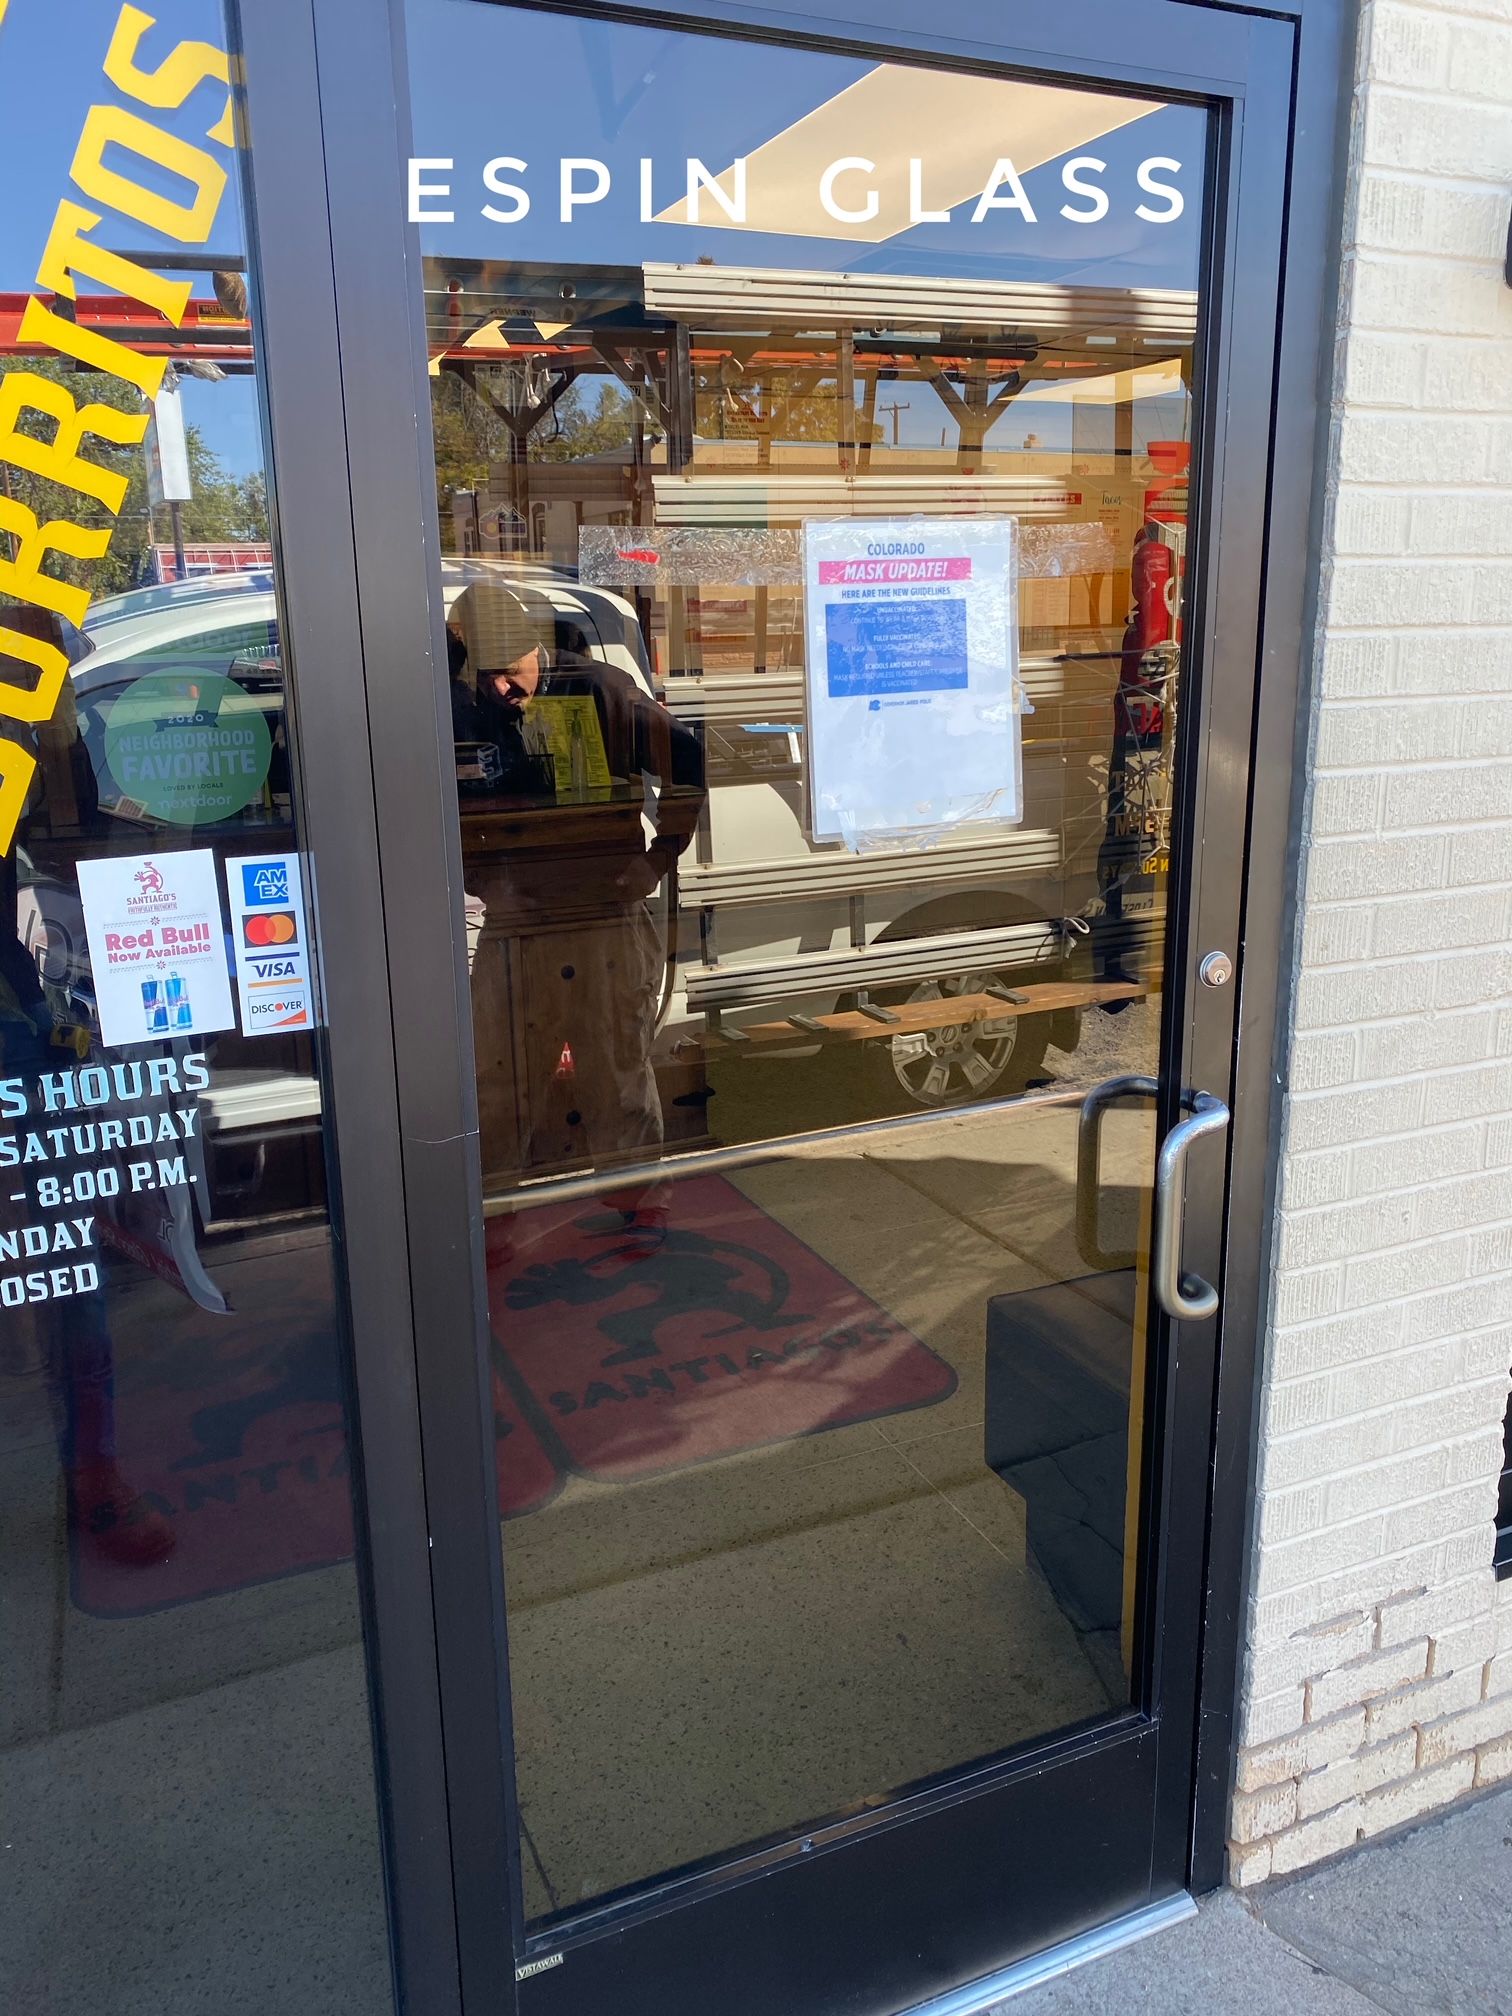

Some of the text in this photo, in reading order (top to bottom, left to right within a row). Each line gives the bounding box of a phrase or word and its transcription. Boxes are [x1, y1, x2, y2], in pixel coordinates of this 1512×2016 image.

[0, 3, 252, 858] URRITOS
[867, 542, 925, 556] COLORADO
[844, 561, 948, 581] MASK UPDATE!
[841, 586, 951, 599] HERE ARE THE NEW GUIDELINES
[168, 713, 204, 725] 2020
[119, 730, 255, 753] NEIGHBORHOOD
[122, 750, 256, 782] FAVORITE
[162, 782, 224, 792] LOVED BY LOCALS
[159, 794, 232, 809] nextdoor
[256, 869, 288, 885] AM
[126, 893, 177, 906] SANTIAGO'S
[104, 922, 210, 952] Red Bull
[107, 943, 212, 964] Now Available
[252, 961, 296, 978] VISA
[251, 1000, 302, 1014] DISCOVER
[38, 1053, 210, 1113] HOURS
[0, 1107, 198, 1167] SATURDAY
[37, 1167, 120, 1208] 8:00
[128, 1156, 198, 1193] P.M.
[0, 1216, 95, 1262] NDAY
